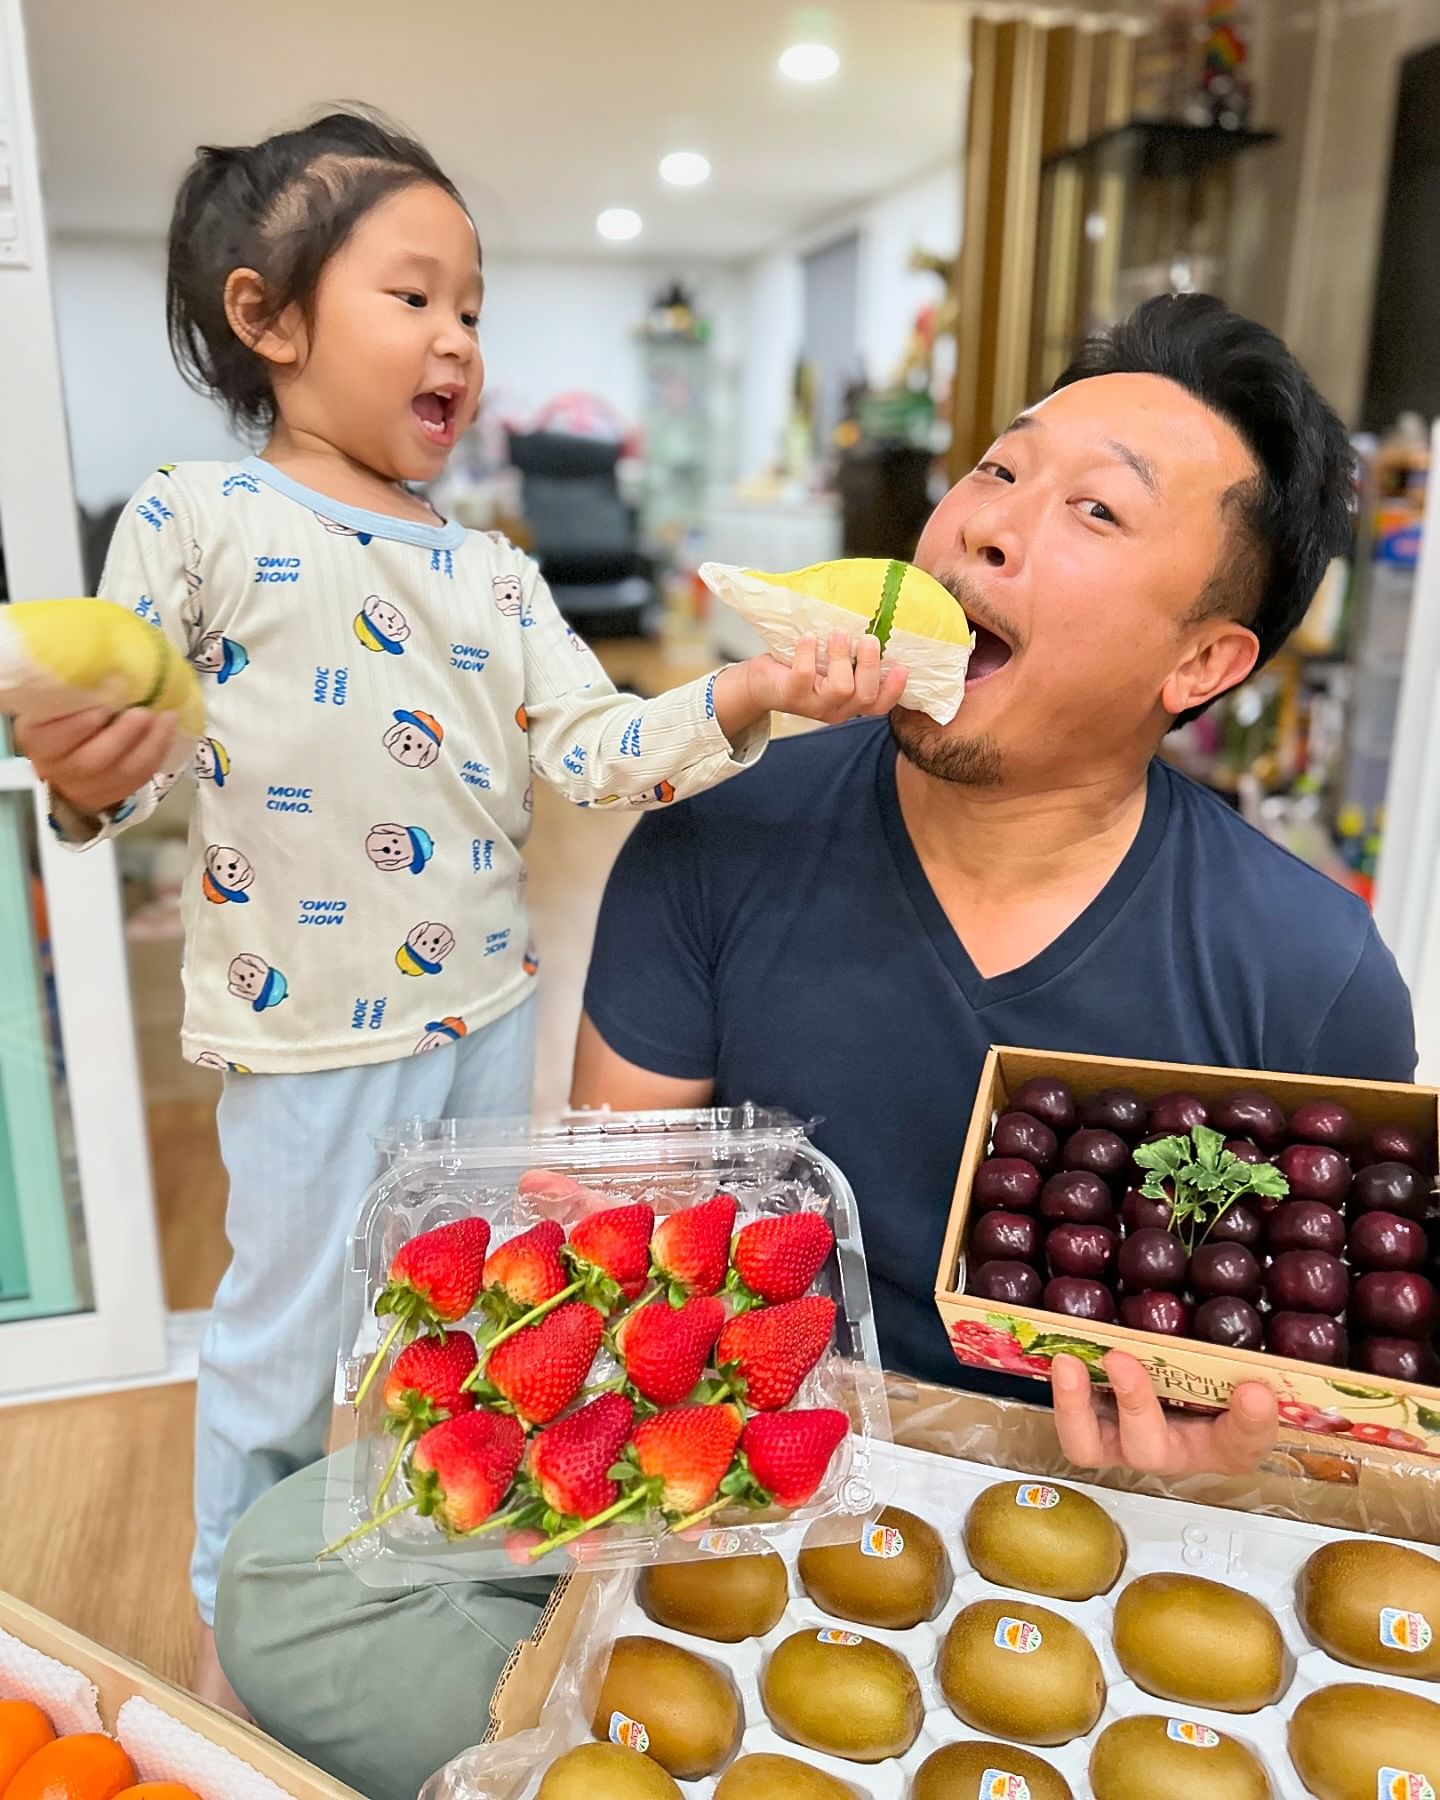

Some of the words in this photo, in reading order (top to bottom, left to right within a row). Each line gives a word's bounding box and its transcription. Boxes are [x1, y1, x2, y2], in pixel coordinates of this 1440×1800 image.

[254, 556, 301, 568] CIMO.
[254, 571, 299, 583] MOIC
[134, 595, 153, 618] OIC
[450, 643, 490, 660] CIMO.
[449, 657, 485, 673] MOIC
[314, 666, 329, 703] MOIC
[333, 667, 348, 706] CIMO.
[267, 786, 313, 799] MOIC
[266, 800, 313, 814] CIMO.
[472, 839, 481, 874] CIMO.
[483, 839, 494, 871] MOIC
[299, 900, 348, 911] CIMO.
[297, 914, 345, 926] MOIC
[351, 997, 368, 1029] MOIC
[370, 996, 388, 1030] CIMO.
[1019, 1623, 1035, 1650] Zespri
